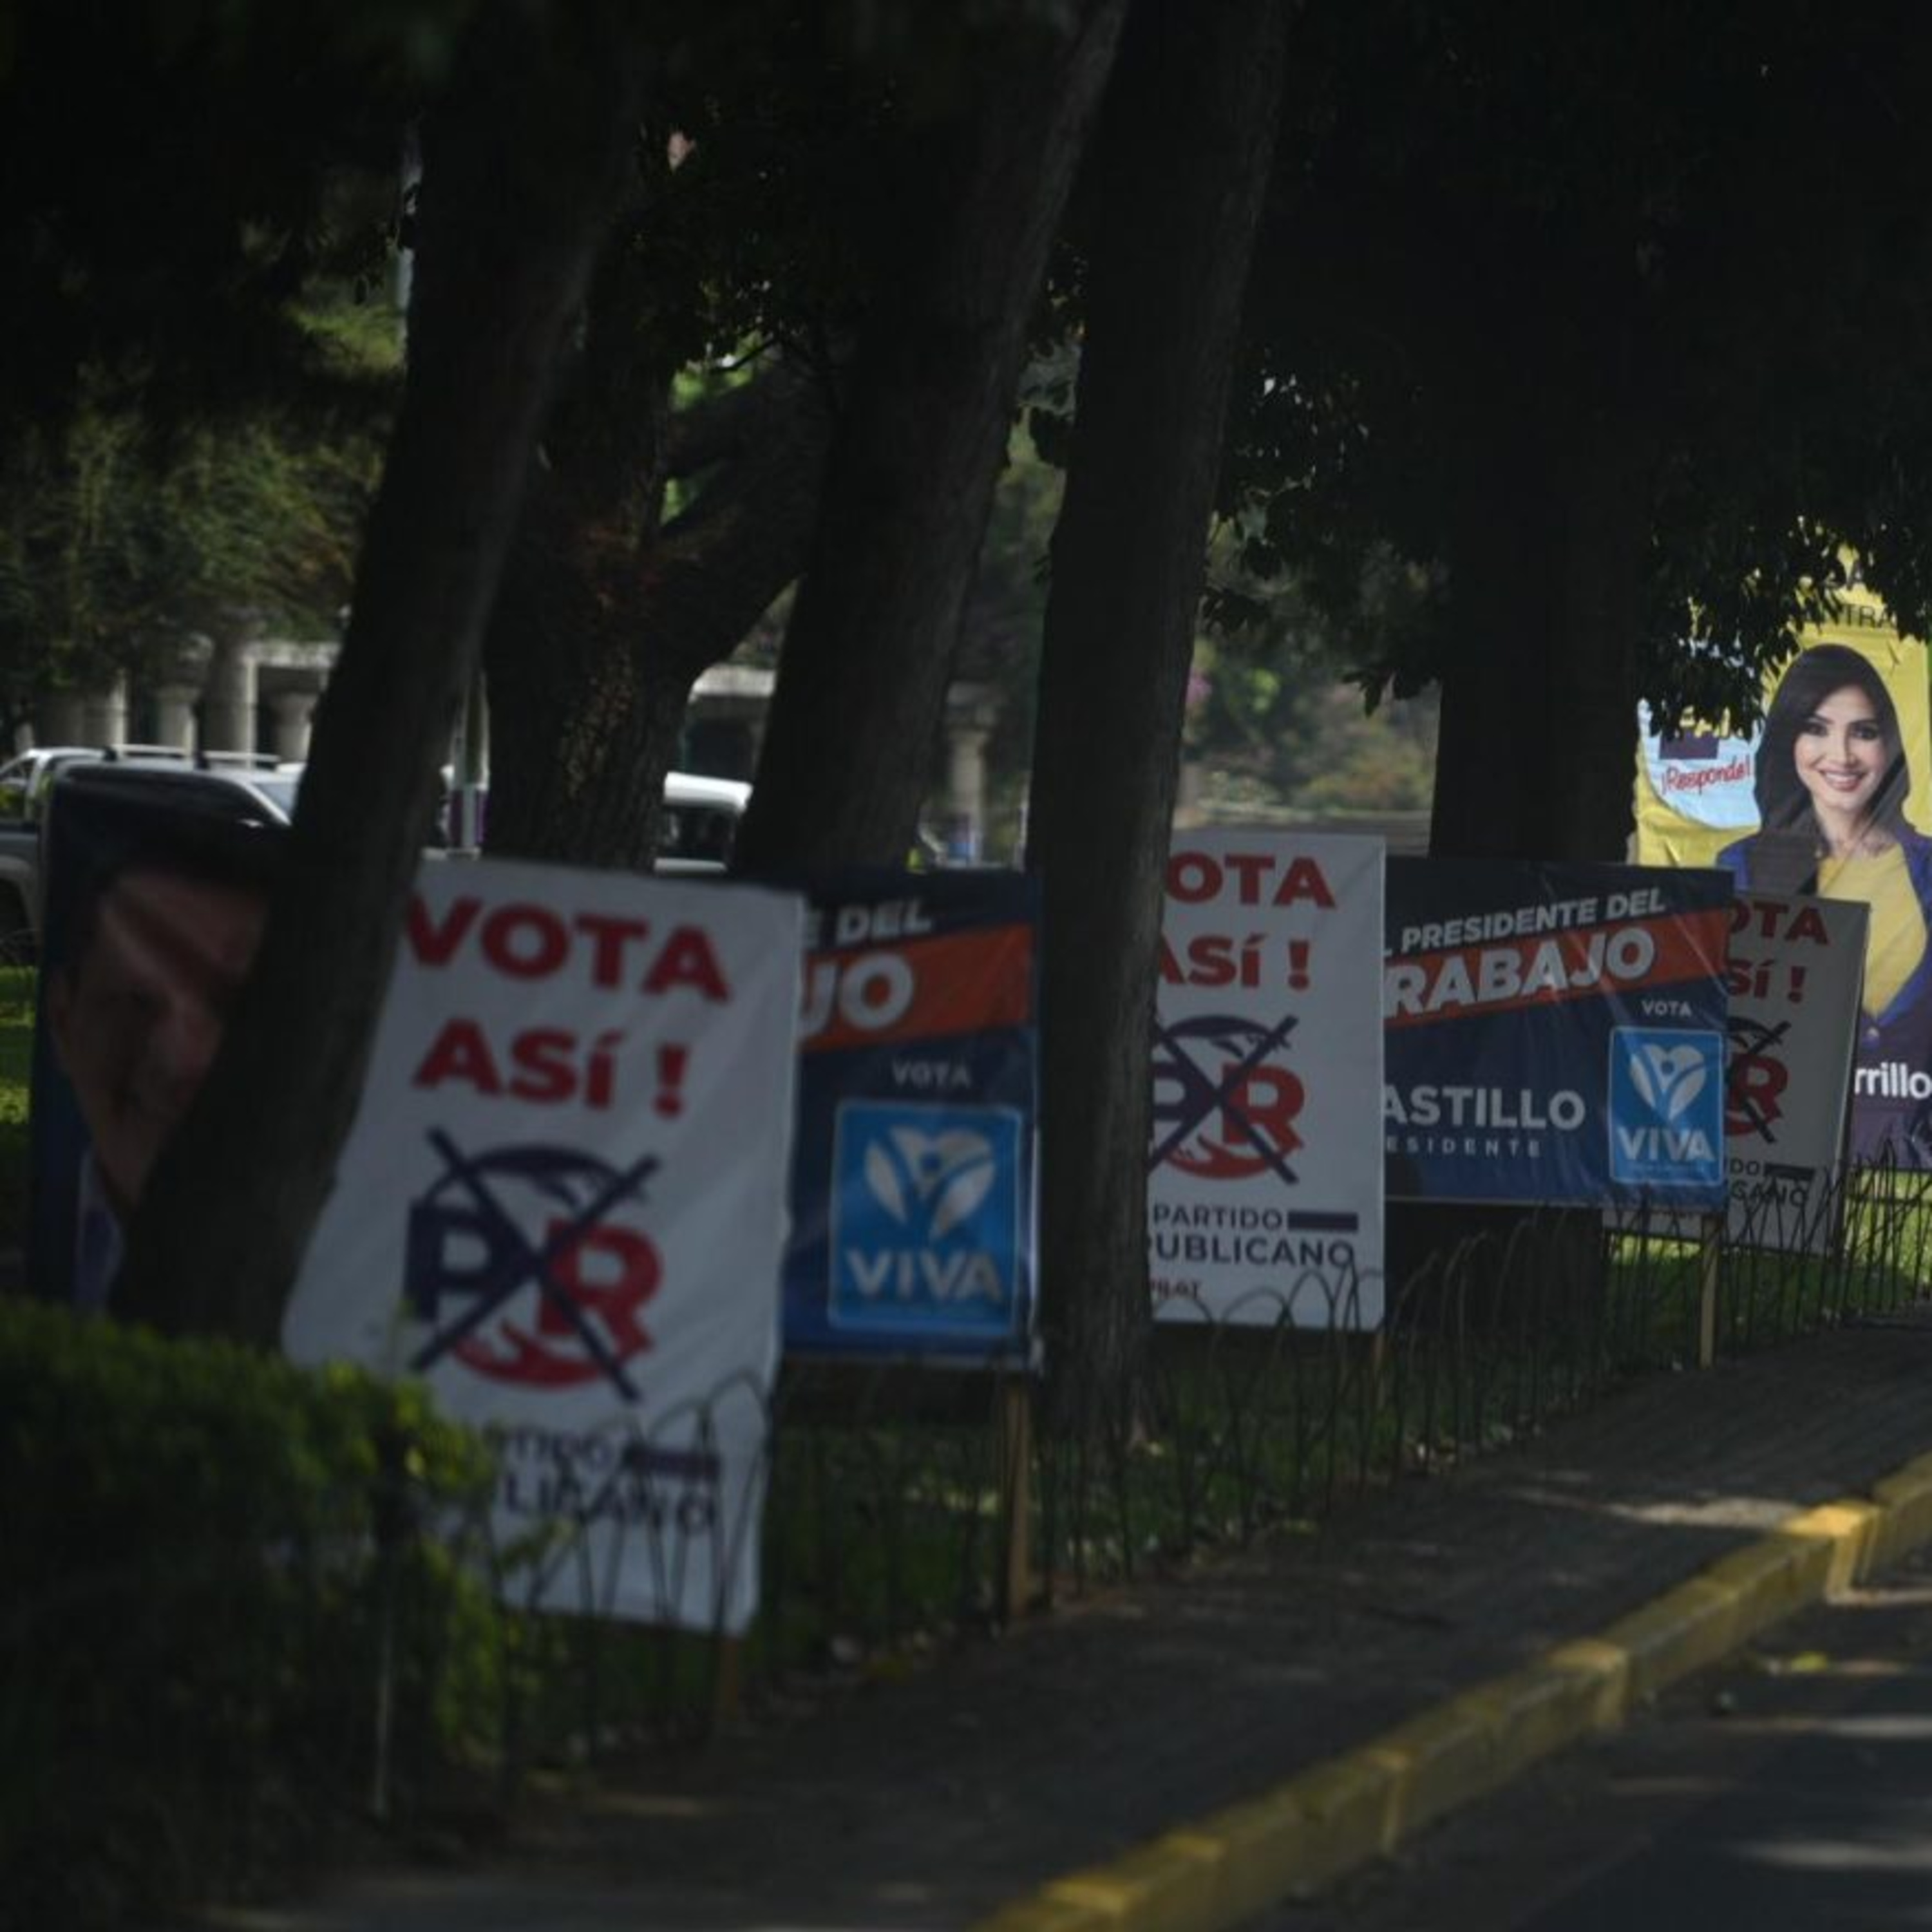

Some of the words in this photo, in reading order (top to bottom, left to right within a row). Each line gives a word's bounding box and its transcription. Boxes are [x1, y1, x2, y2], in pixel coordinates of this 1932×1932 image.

[837, 897, 933, 945] DEL
[1401, 896, 1598, 954] PRESIDENTE
[1607, 887, 1667, 920] DEL
[406, 895, 732, 1005] VOTA
[1383, 926, 1656, 1020] RABAJO
[1642, 999, 1692, 1018] VOTA
[892, 1057, 972, 1090] VOTA
[1385, 1084, 1586, 1131] ASTILLO
[1386, 1135, 1541, 1158] ESIDENTE
[1616, 1126, 1718, 1162] VIVA
[1153, 1204, 1284, 1231] PARTIDO
[1157, 1235, 1354, 1269] UBLICANO
[845, 1247, 1003, 1305] VIVA
